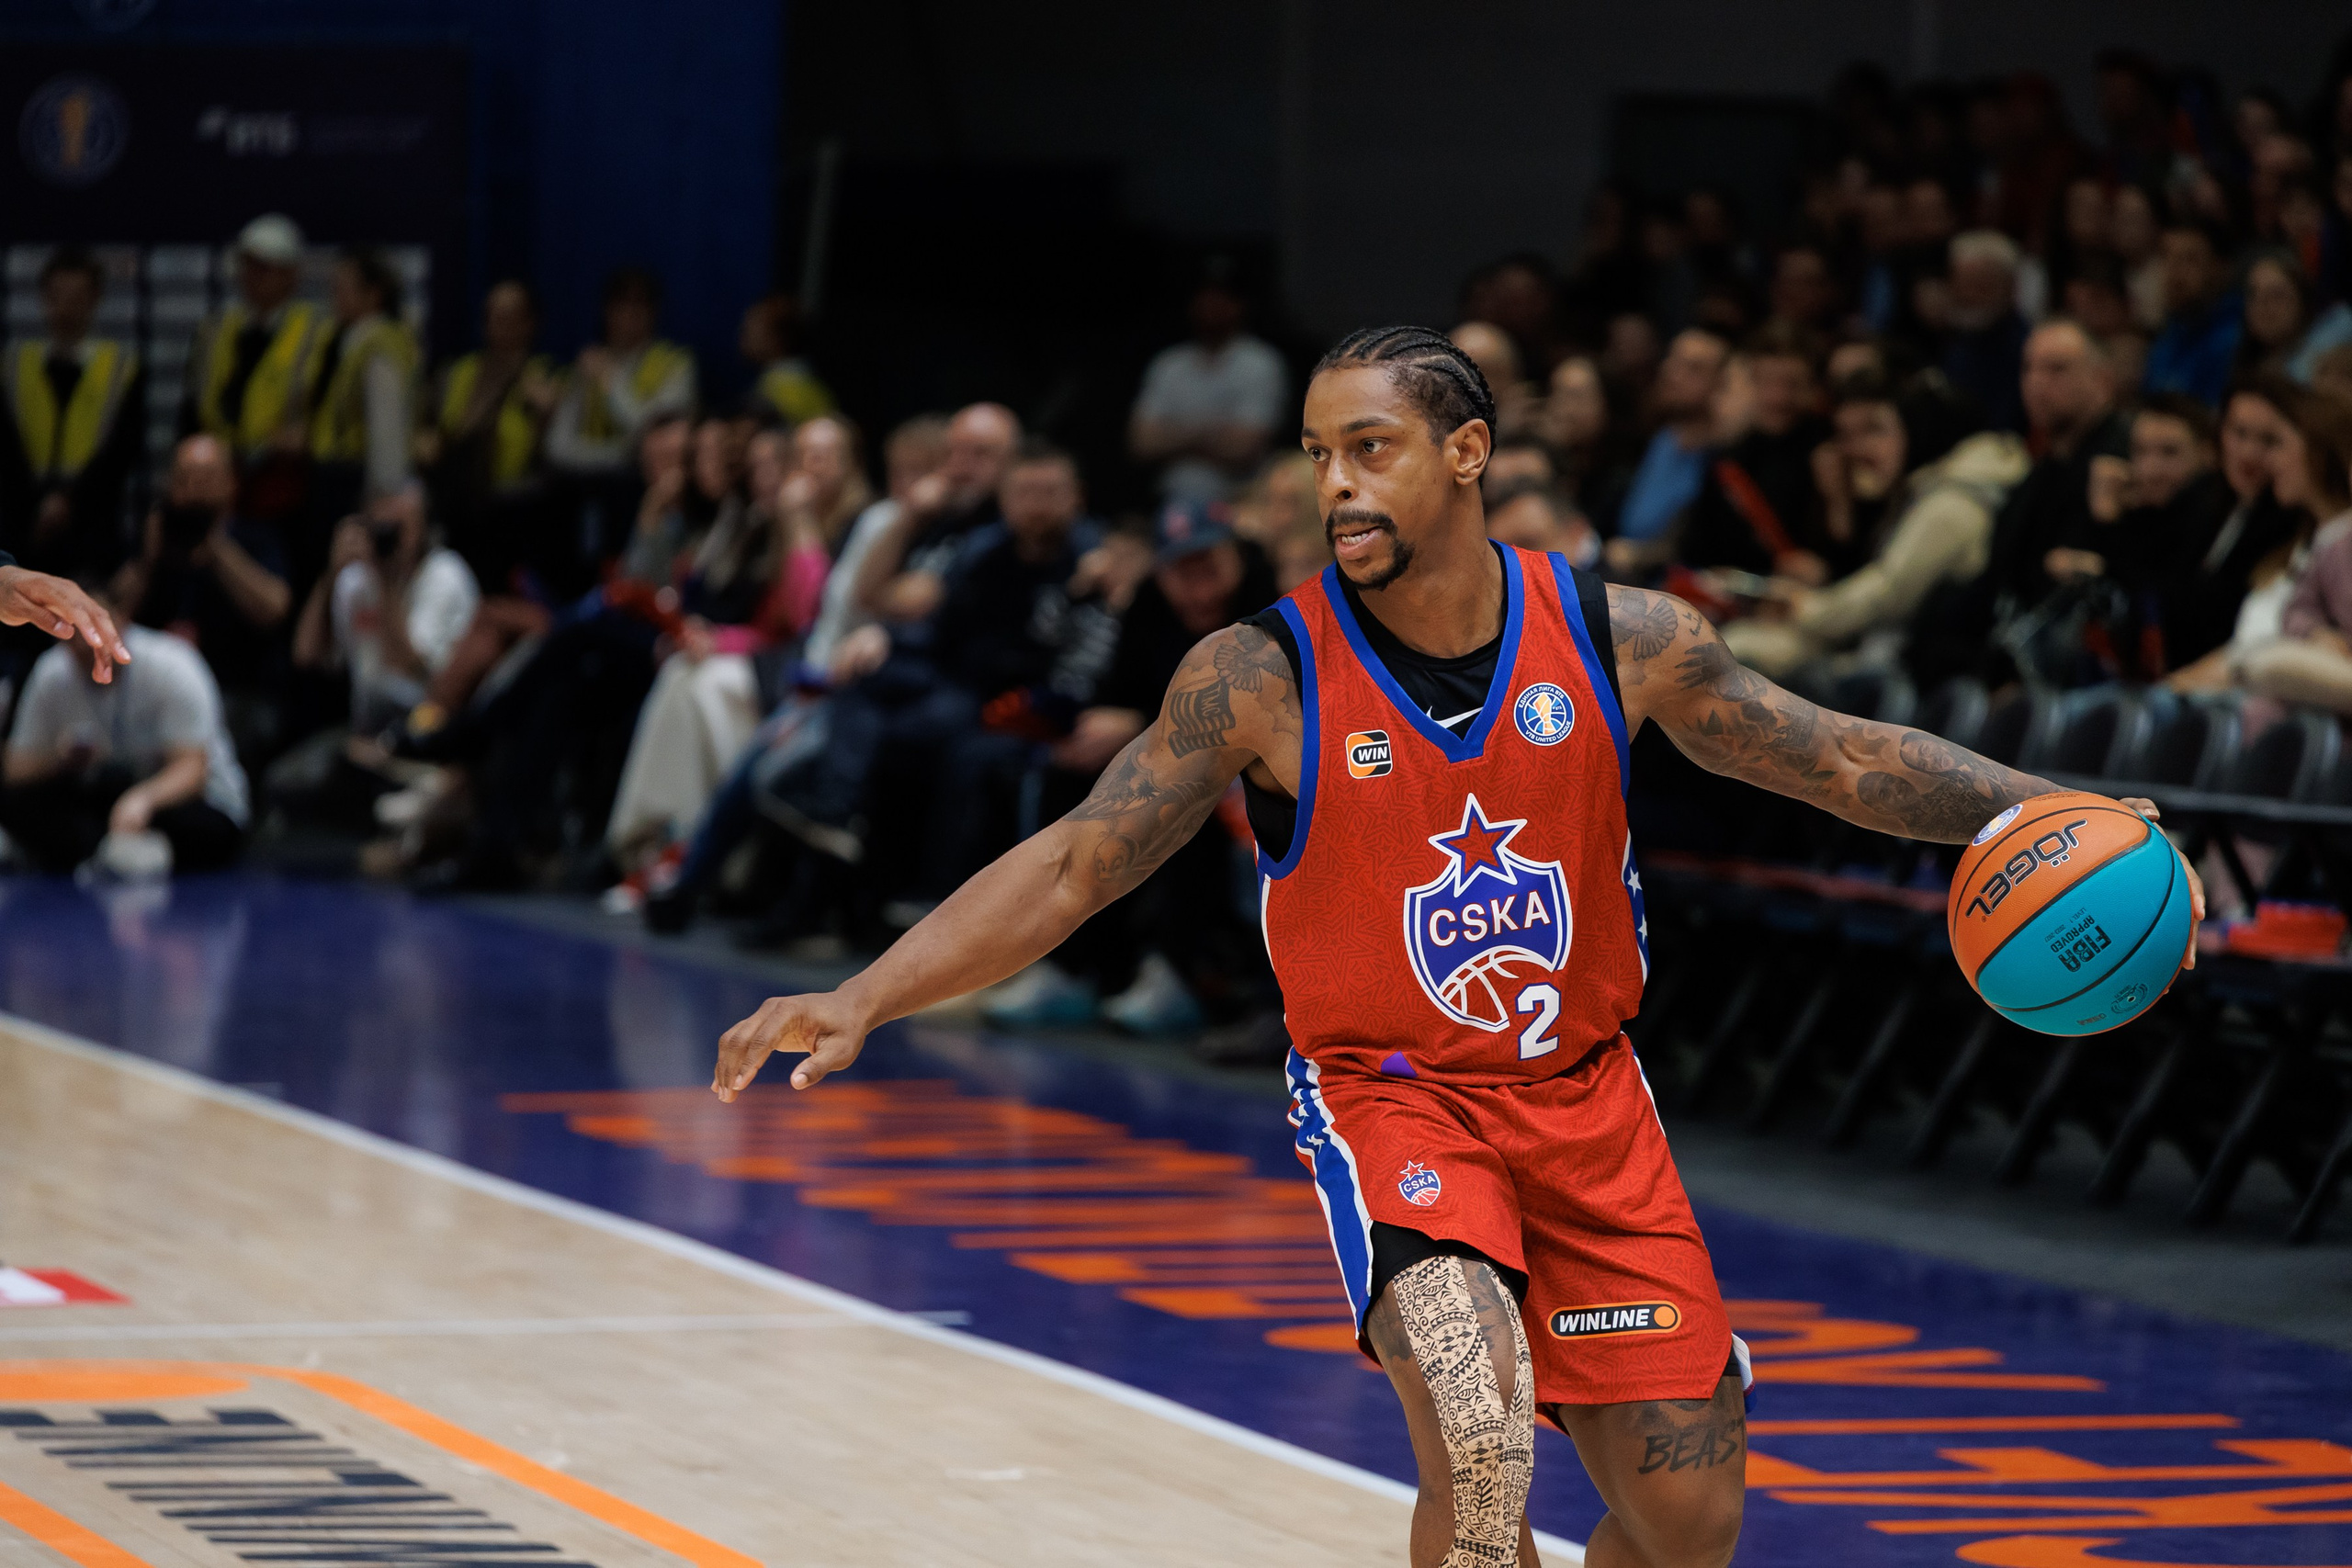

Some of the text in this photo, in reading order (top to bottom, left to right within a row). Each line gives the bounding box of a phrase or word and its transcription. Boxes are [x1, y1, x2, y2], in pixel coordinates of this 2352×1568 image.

[1518, 687, 1538, 708] ЕДИНАЯ
[1555, 690, 1565, 699] ВТБ
[1525, 729, 1536, 739] VTB
[1556, 720, 1572, 739] LEAGUE
[1358, 746, 1388, 761] WIN
[1965, 818, 2088, 918] JÖGEL
[1429, 890, 1552, 947] CSKA
[2050, 915, 2095, 953] APPROVED
[2058, 925, 2112, 973] FIBA
[1516, 981, 1561, 1061] 2
[1403, 1175, 1436, 1192] CSKA
[1559, 1308, 1649, 1332] WINLINE
